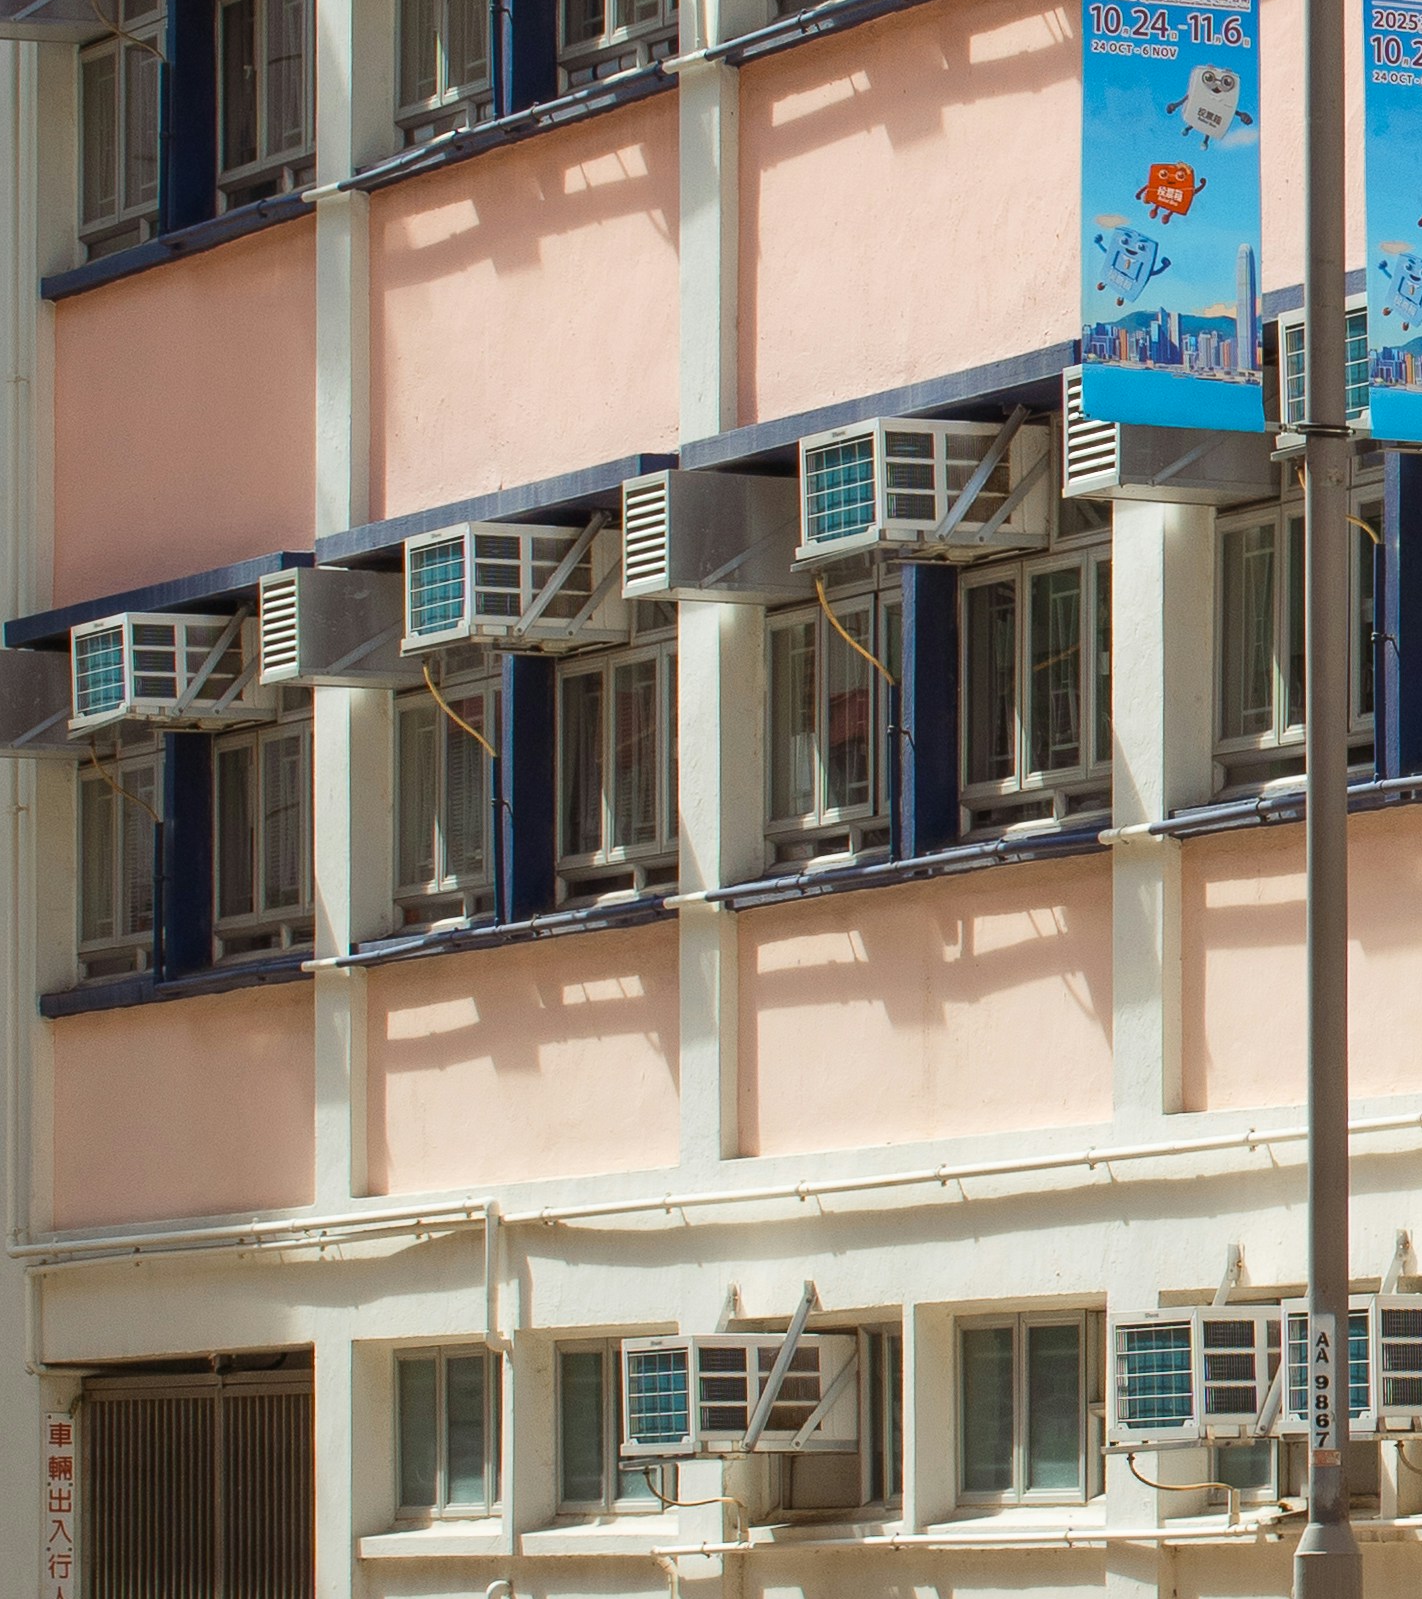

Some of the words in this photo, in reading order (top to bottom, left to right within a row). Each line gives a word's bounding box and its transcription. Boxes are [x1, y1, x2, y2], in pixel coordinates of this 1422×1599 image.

[1373, 10, 1419, 31] 2025
[1092, 41, 1106, 52] 24
[1109, 42, 1133, 54] OCT
[1142, 45, 1150, 56] 6
[1152, 46, 1178, 58] NOV
[1373, 70, 1388, 82] 24
[1389, 72, 1414, 85] OCT
[1315, 1331, 1330, 1364] AA
[1314, 1374, 1330, 1448] 9867
